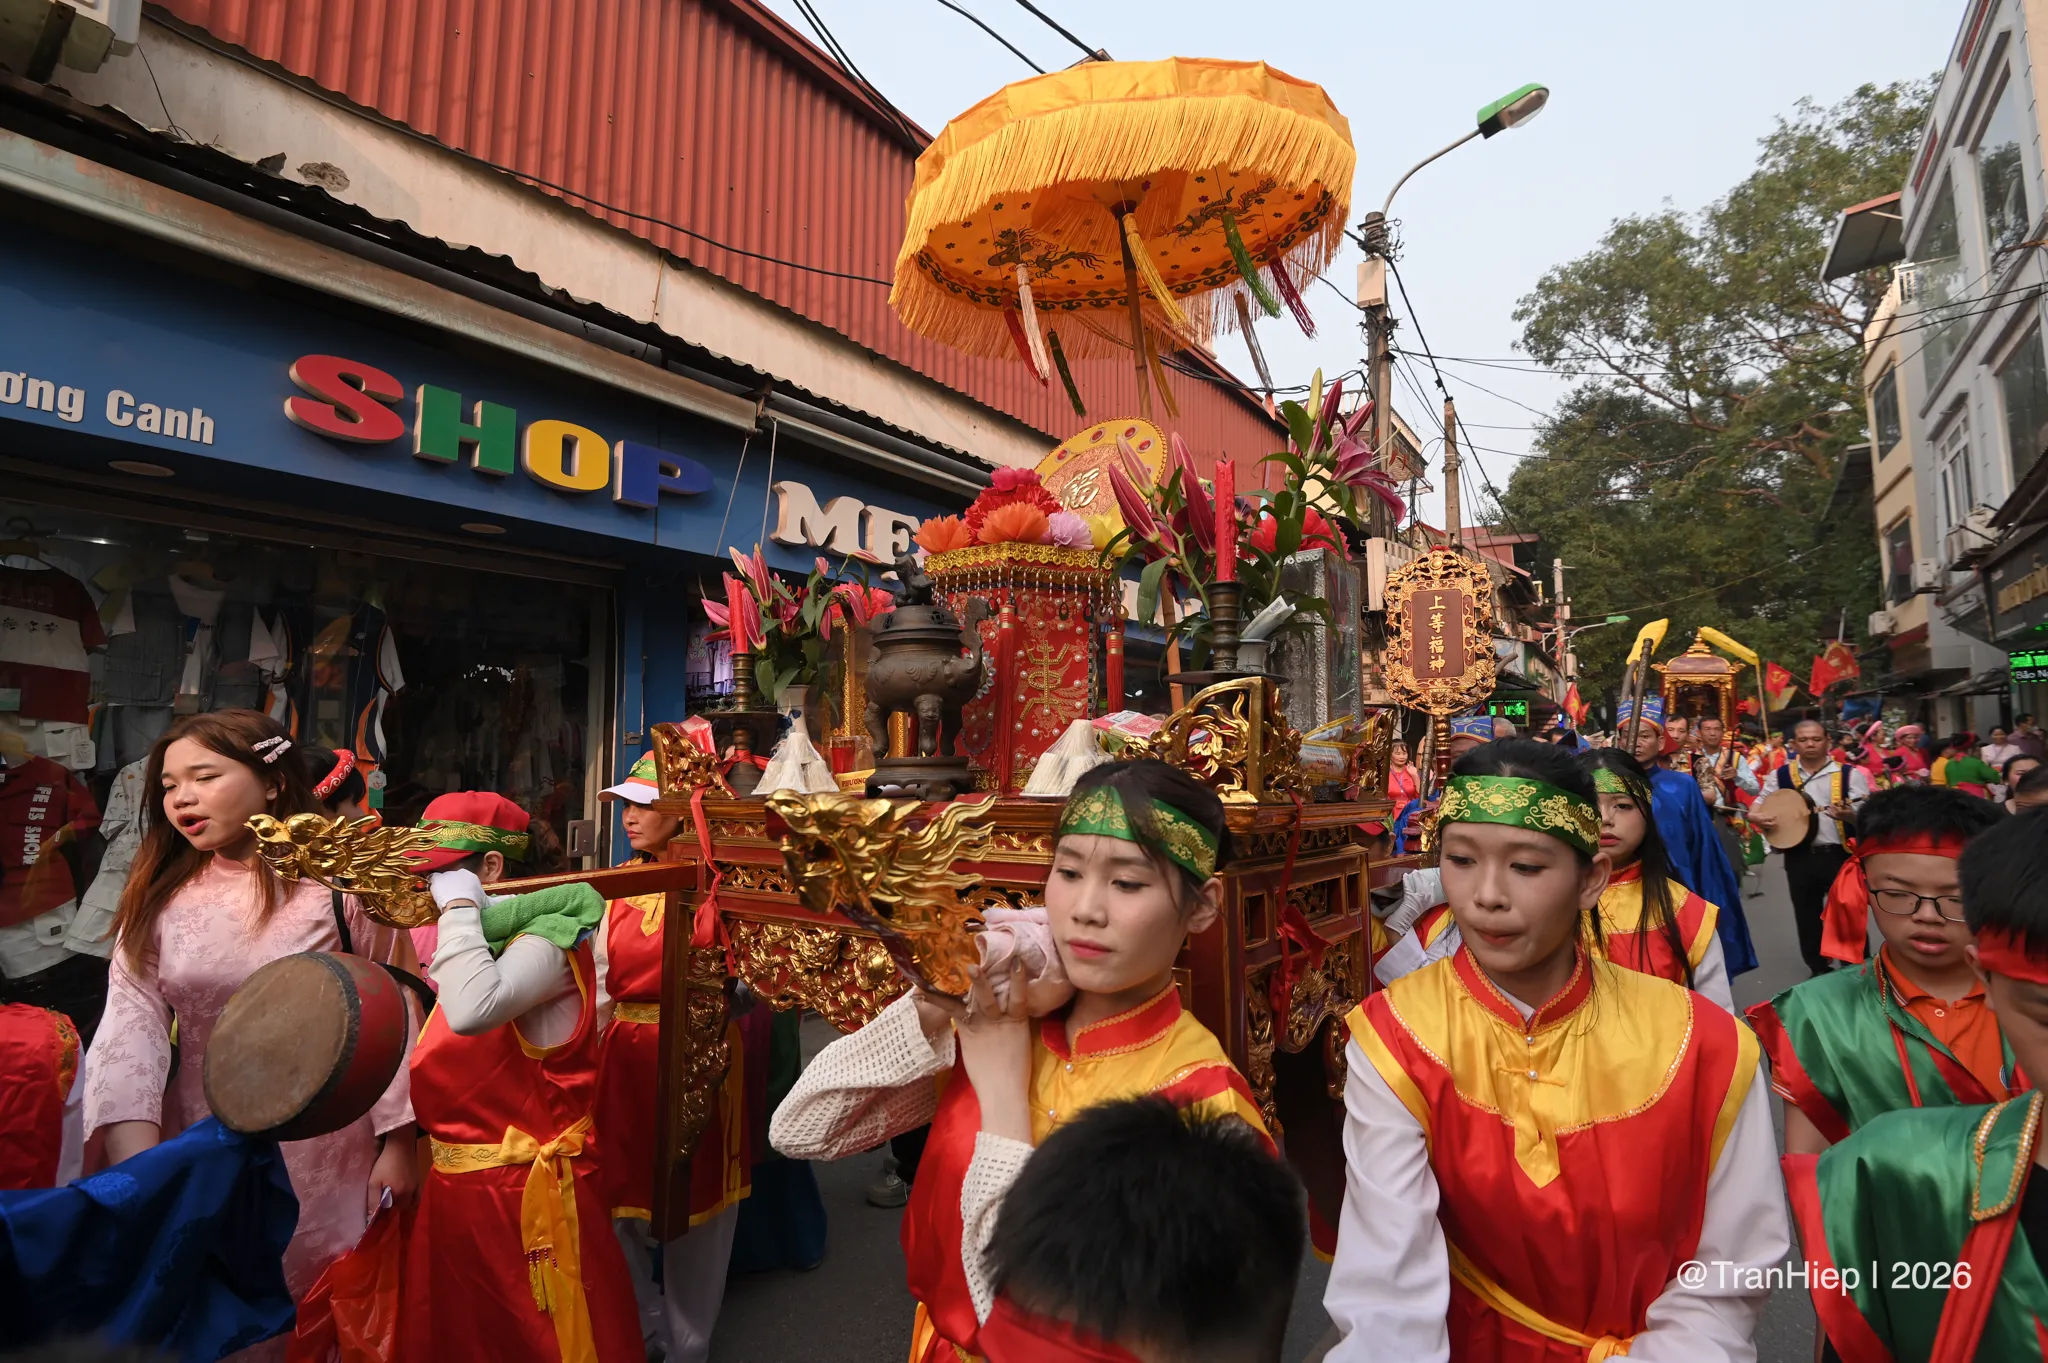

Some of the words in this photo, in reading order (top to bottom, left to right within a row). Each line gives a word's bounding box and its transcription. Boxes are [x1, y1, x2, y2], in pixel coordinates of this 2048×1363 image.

[0, 371, 85, 423] ơng
[106, 389, 215, 445] Canh
[284, 354, 714, 509] SHOP
[1428, 595, 1447, 674] 上等福神
[28, 807, 46, 820] IS
